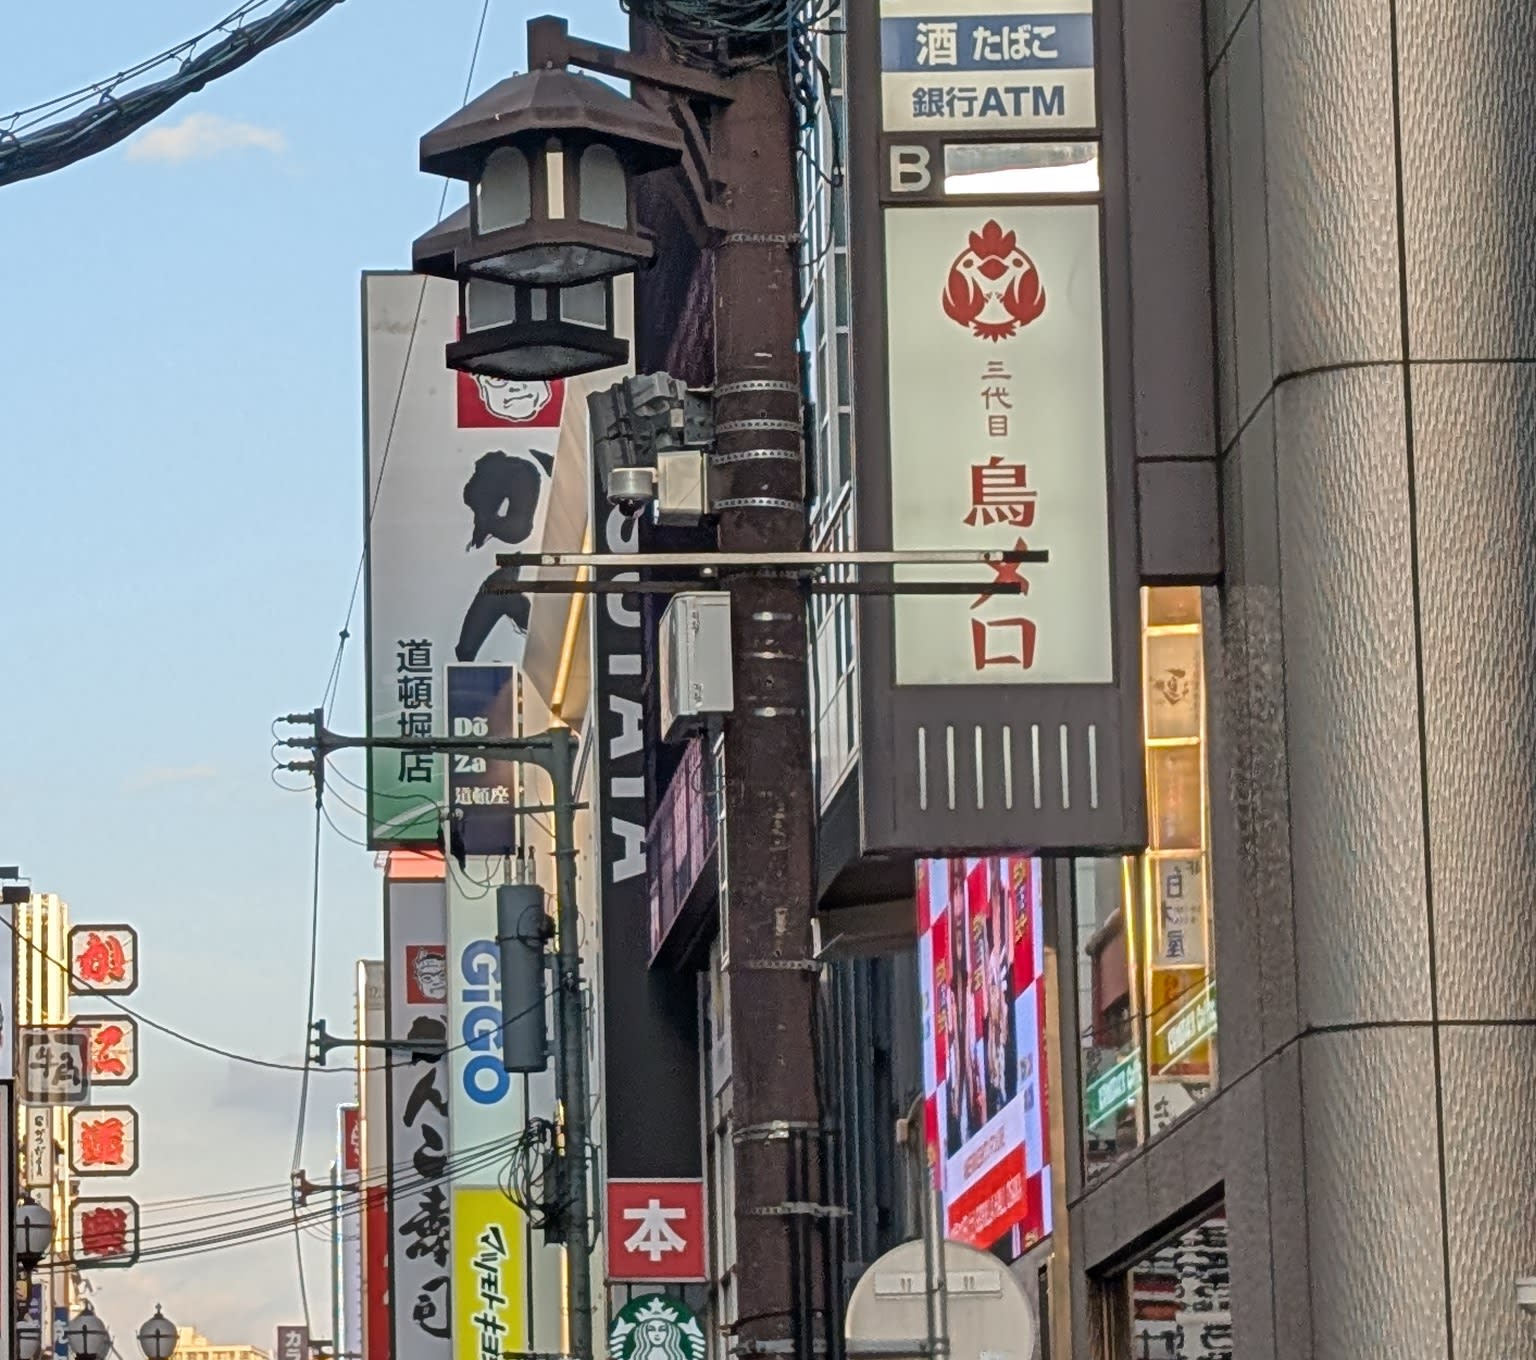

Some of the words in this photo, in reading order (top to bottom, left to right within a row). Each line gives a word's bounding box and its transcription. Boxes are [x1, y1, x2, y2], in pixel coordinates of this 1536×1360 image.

[916, 22, 958, 67] 酒
[972, 25, 1059, 62] たばこ
[912, 86, 1066, 119] 銀行ATM
[890, 145, 931, 192] B
[980, 360, 1013, 438] 三代目
[963, 456, 1038, 671] 鳥メロ
[397, 639, 434, 783] 道頓堀店
[623, 1198, 687, 1262] 本
